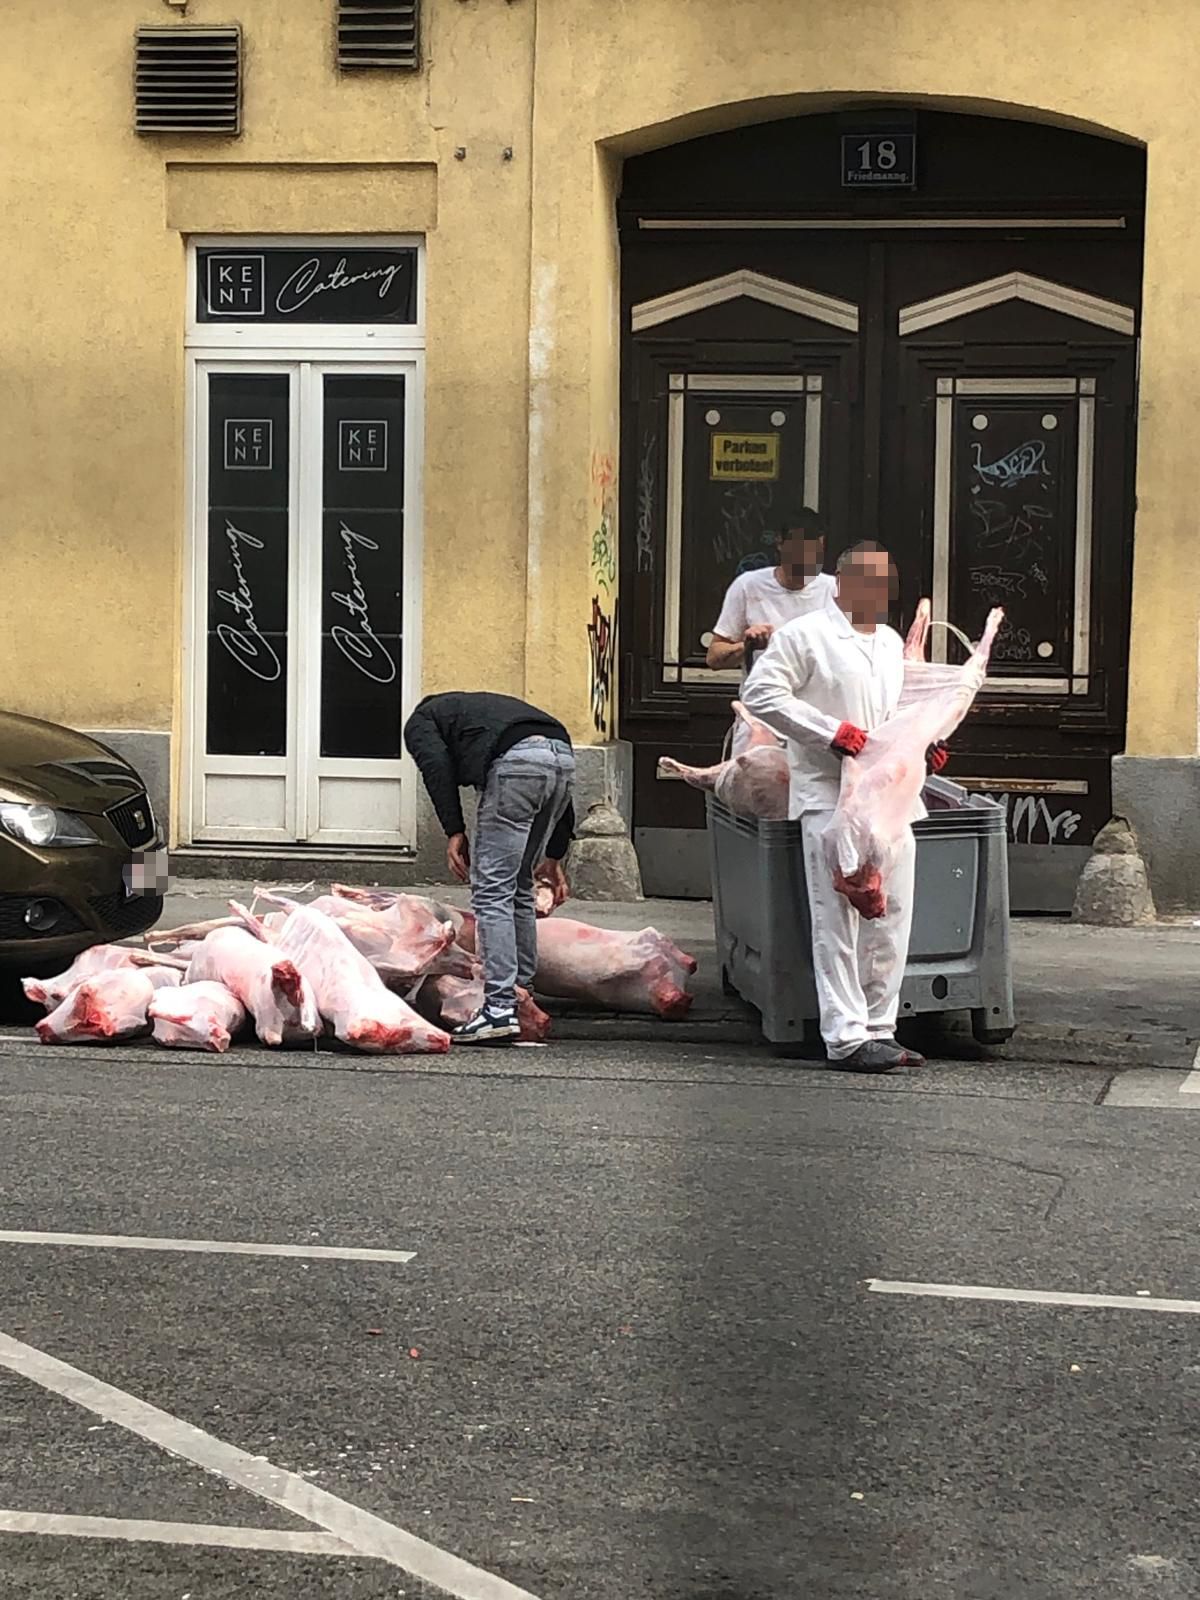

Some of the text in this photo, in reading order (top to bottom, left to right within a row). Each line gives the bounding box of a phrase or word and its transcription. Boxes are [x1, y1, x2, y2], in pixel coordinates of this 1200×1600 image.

[857, 140, 897, 169] 18
[276, 258, 402, 313] Catering
[715, 459, 774, 473] verboten!
[723, 439, 767, 454] Parken
[217, 519, 281, 681] Catering
[331, 520, 396, 683] Catering
